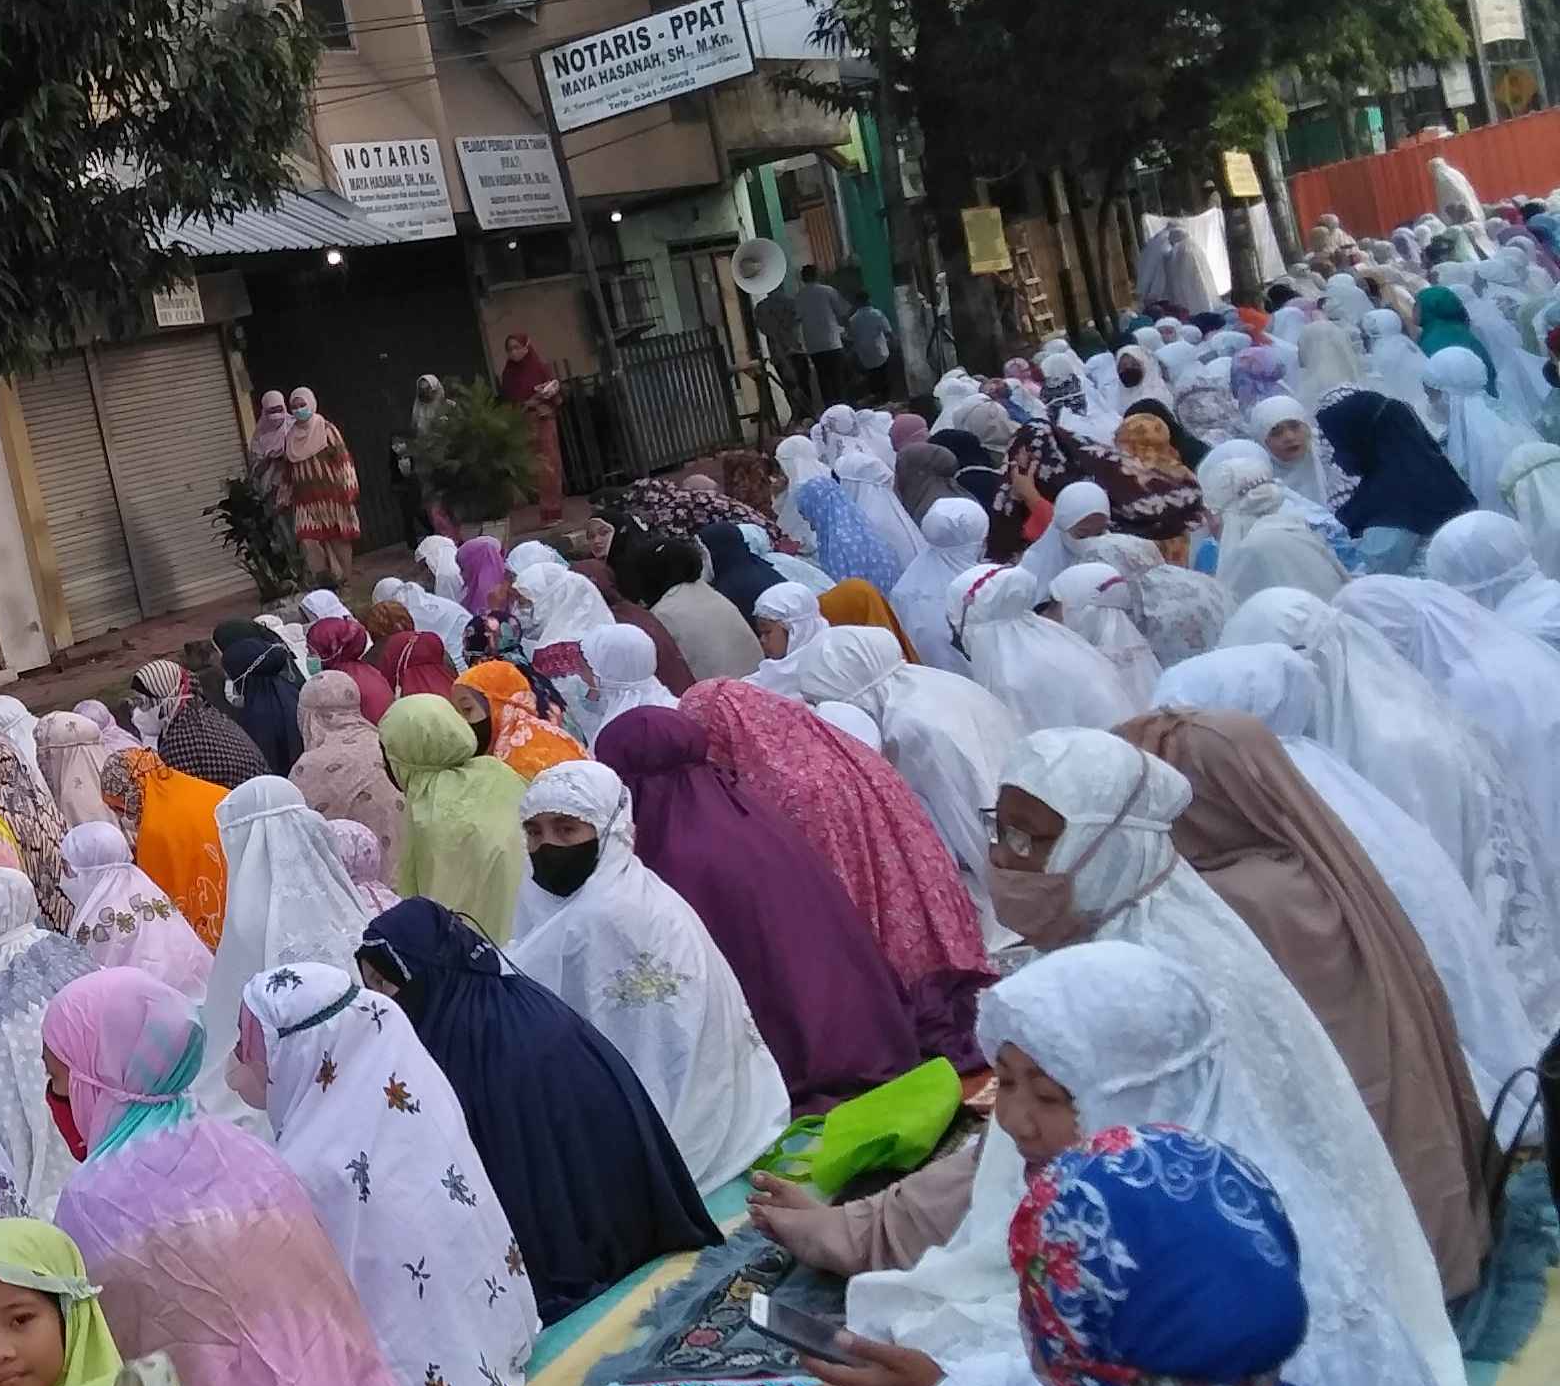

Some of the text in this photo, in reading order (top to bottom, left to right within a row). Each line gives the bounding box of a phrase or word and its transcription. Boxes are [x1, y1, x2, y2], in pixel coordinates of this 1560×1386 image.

[552, 26, 651, 78] NOTARIS
[670, 0, 725, 40] PPAT
[561, 75, 597, 98] MAYA
[599, 53, 665, 85] HASANAH,
[696, 33, 733, 54] M.Kn.
[344, 144, 430, 169] NOTARIS
[349, 176, 369, 191] MAYA
